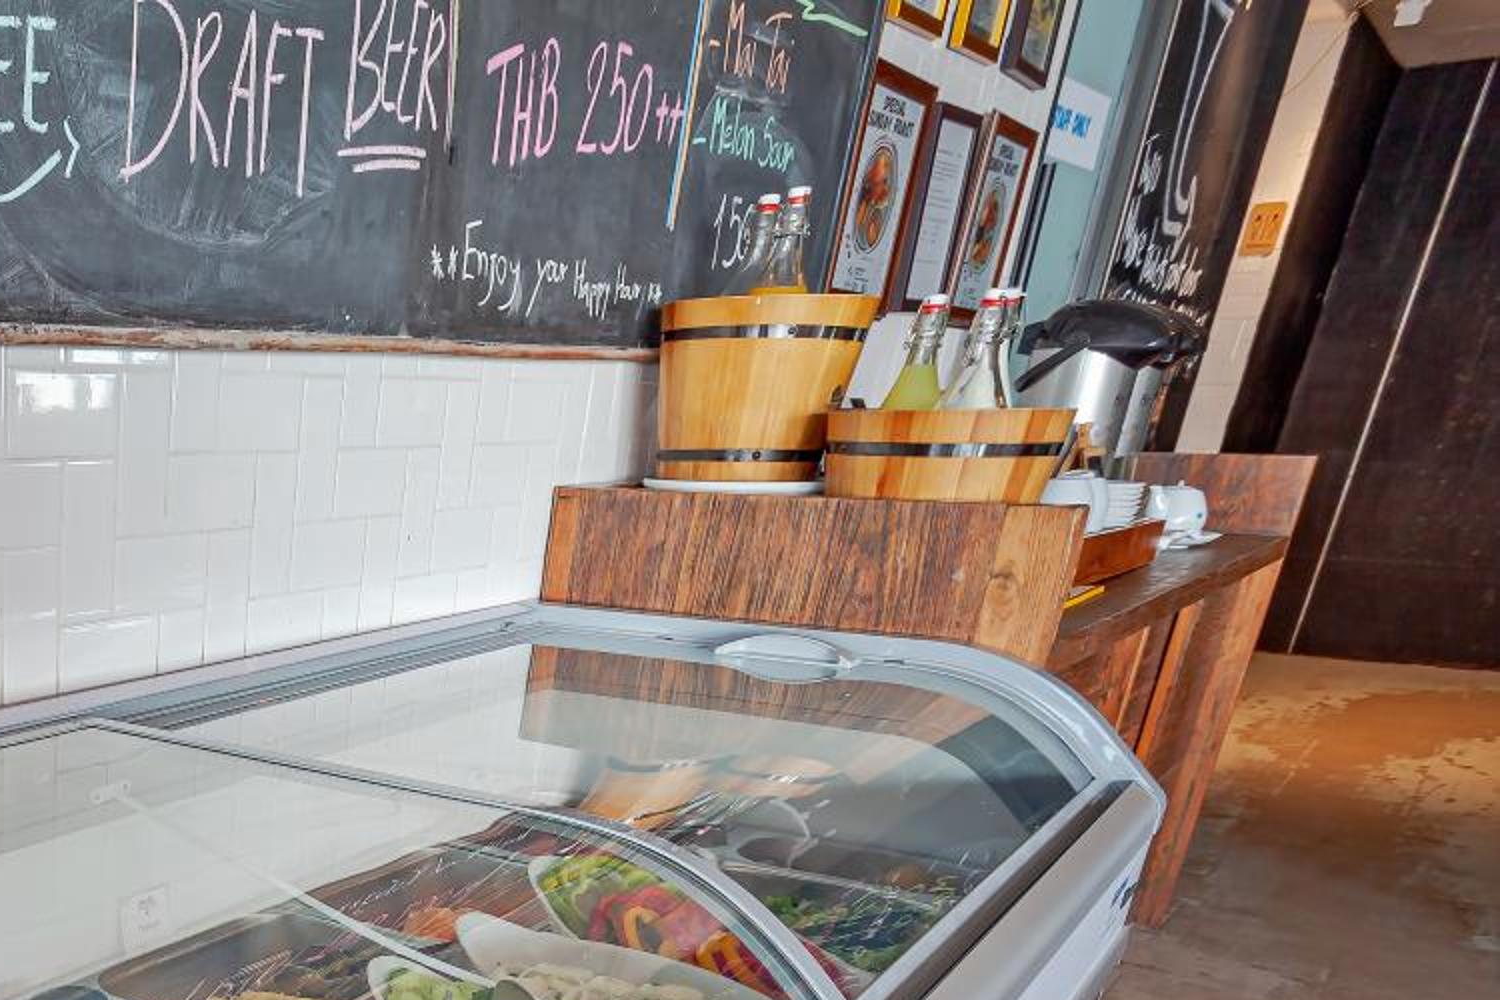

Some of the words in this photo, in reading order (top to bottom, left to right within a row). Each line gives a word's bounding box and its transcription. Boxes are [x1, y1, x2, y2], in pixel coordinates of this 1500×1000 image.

[117, 0, 325, 199] DRAFT
[343, 0, 445, 141] BEER
[485, 37, 561, 166] THB
